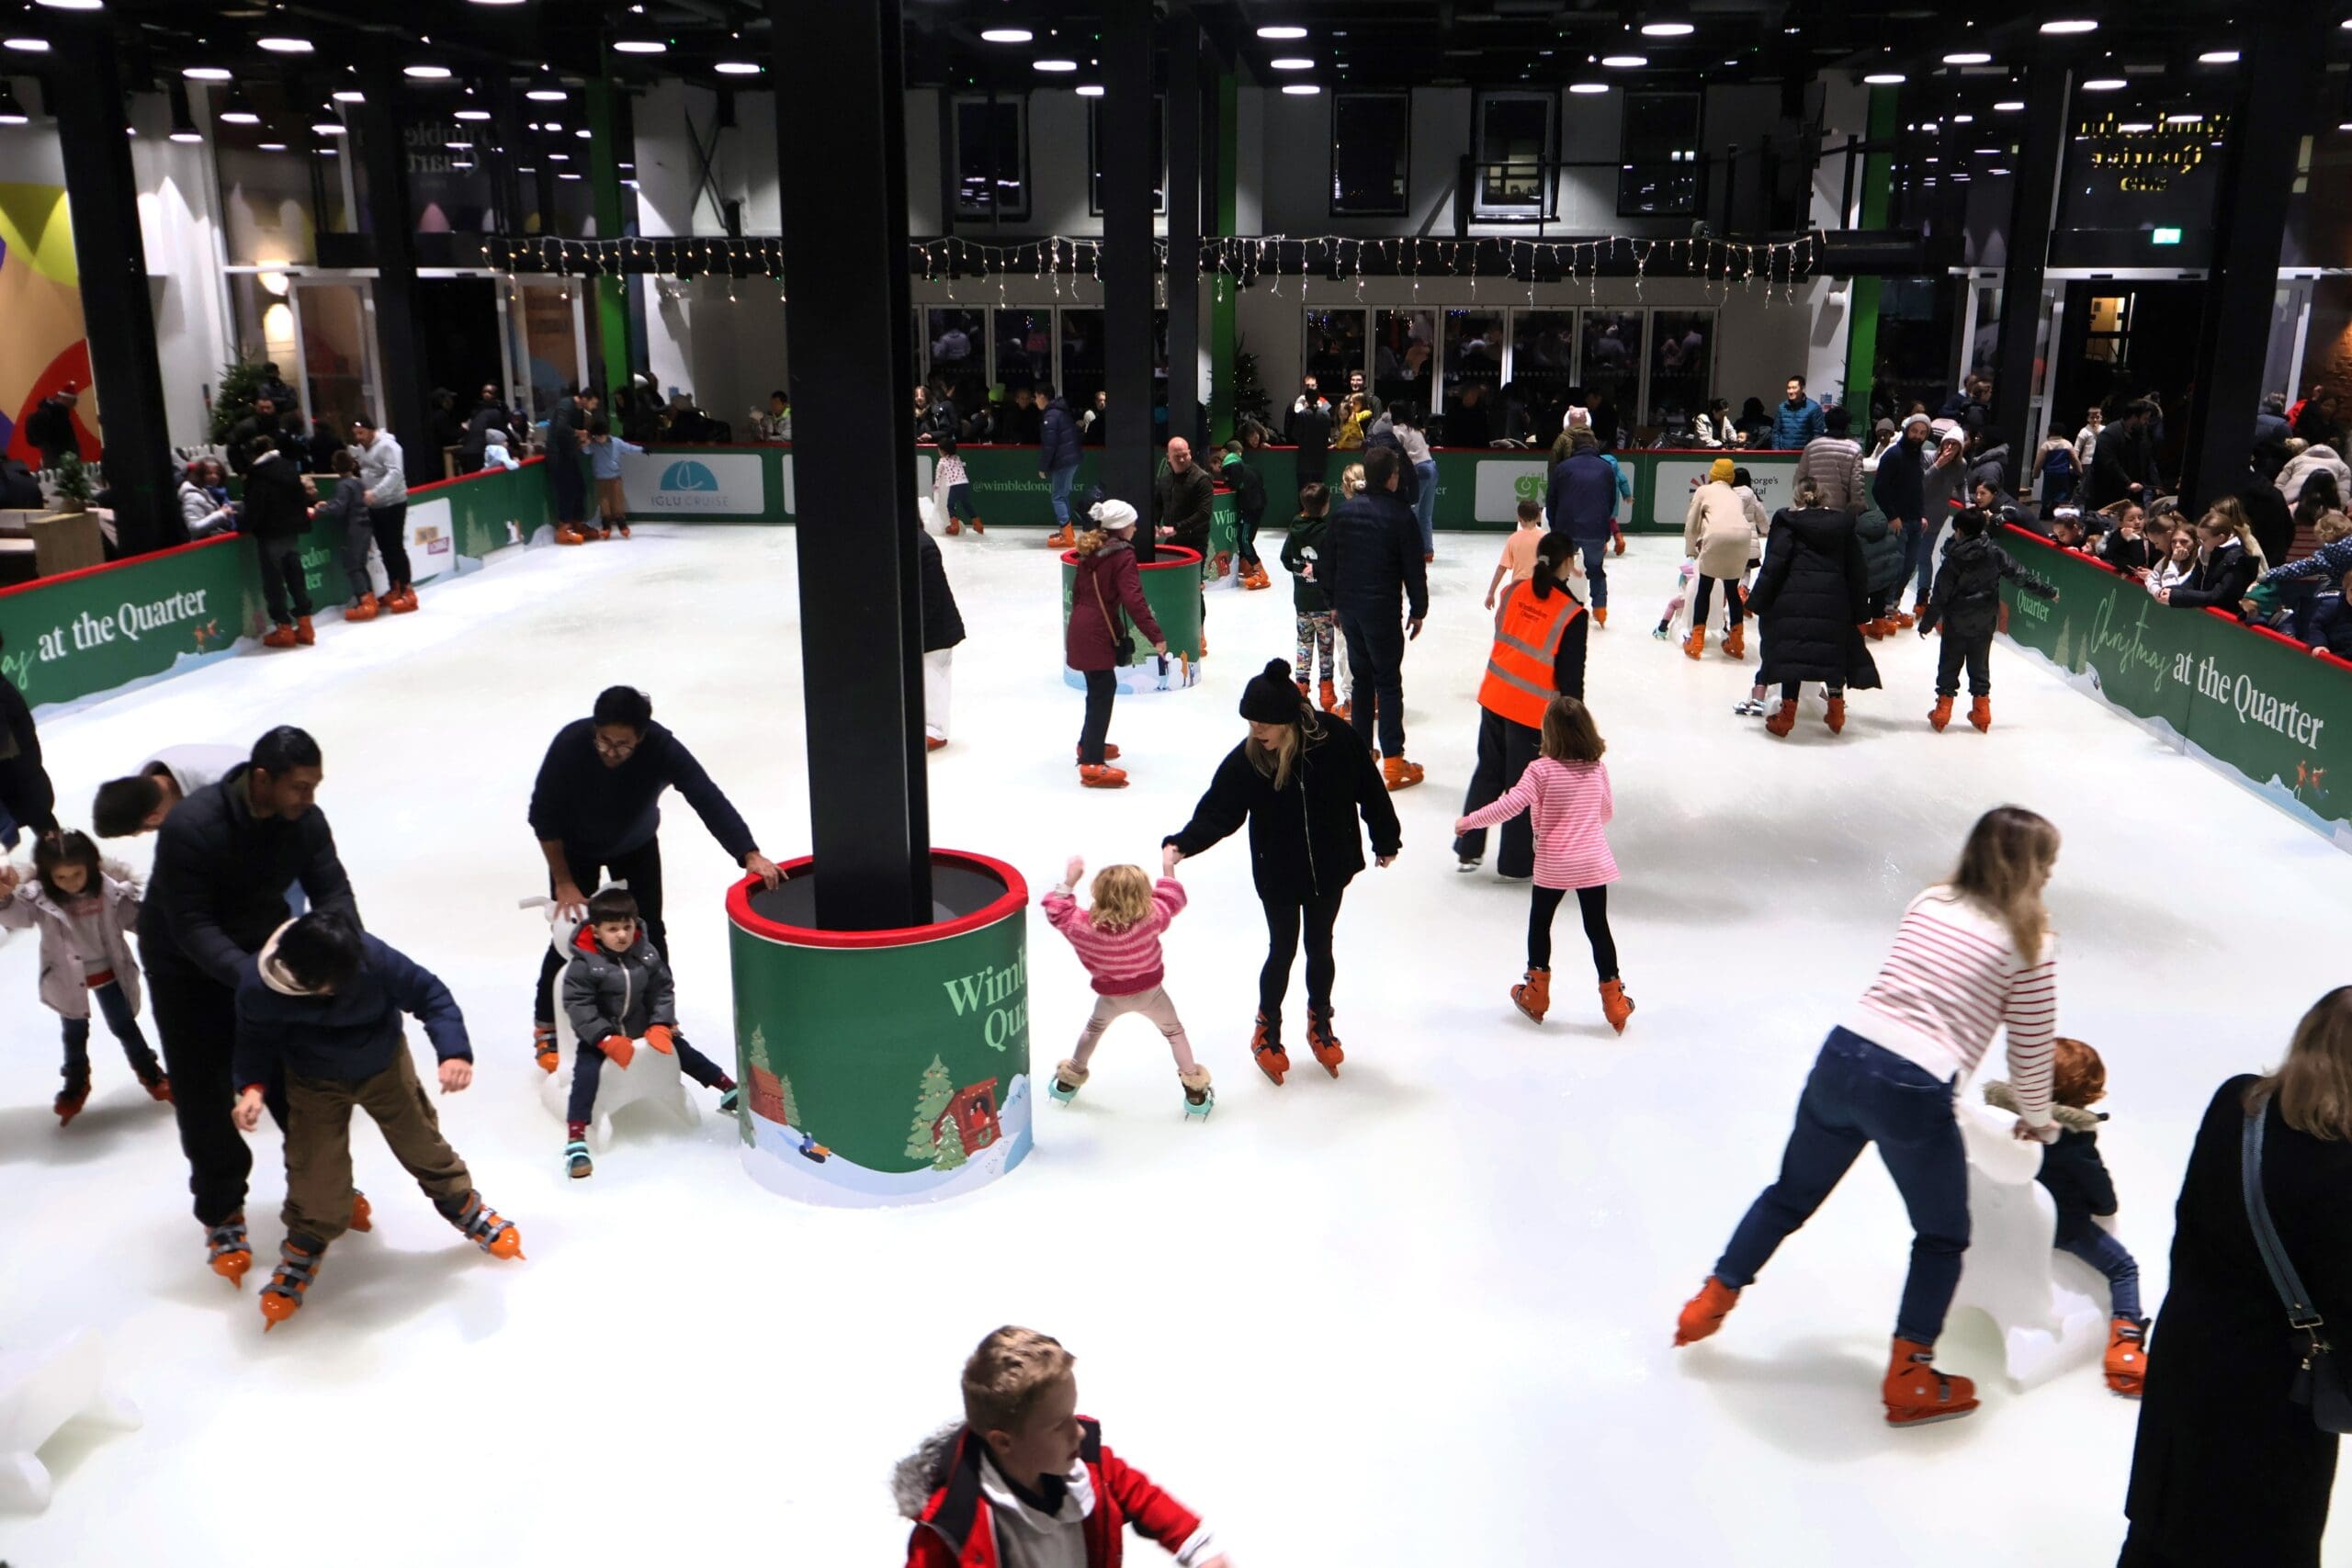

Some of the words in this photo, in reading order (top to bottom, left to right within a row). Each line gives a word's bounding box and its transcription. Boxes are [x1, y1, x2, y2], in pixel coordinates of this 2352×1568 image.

[650, 496, 681, 506] IGLU
[684, 496, 729, 507] CRUISE
[973, 479, 1084, 493] @wimbledonqter
[2018, 589, 2050, 622] Quarter
[39, 626, 67, 661] at
[72, 611, 116, 650] the
[118, 589, 207, 641] Quarter
[2173, 651, 2194, 685] at
[2197, 656, 2232, 705] the
[2234, 674, 2324, 750] Quarter
